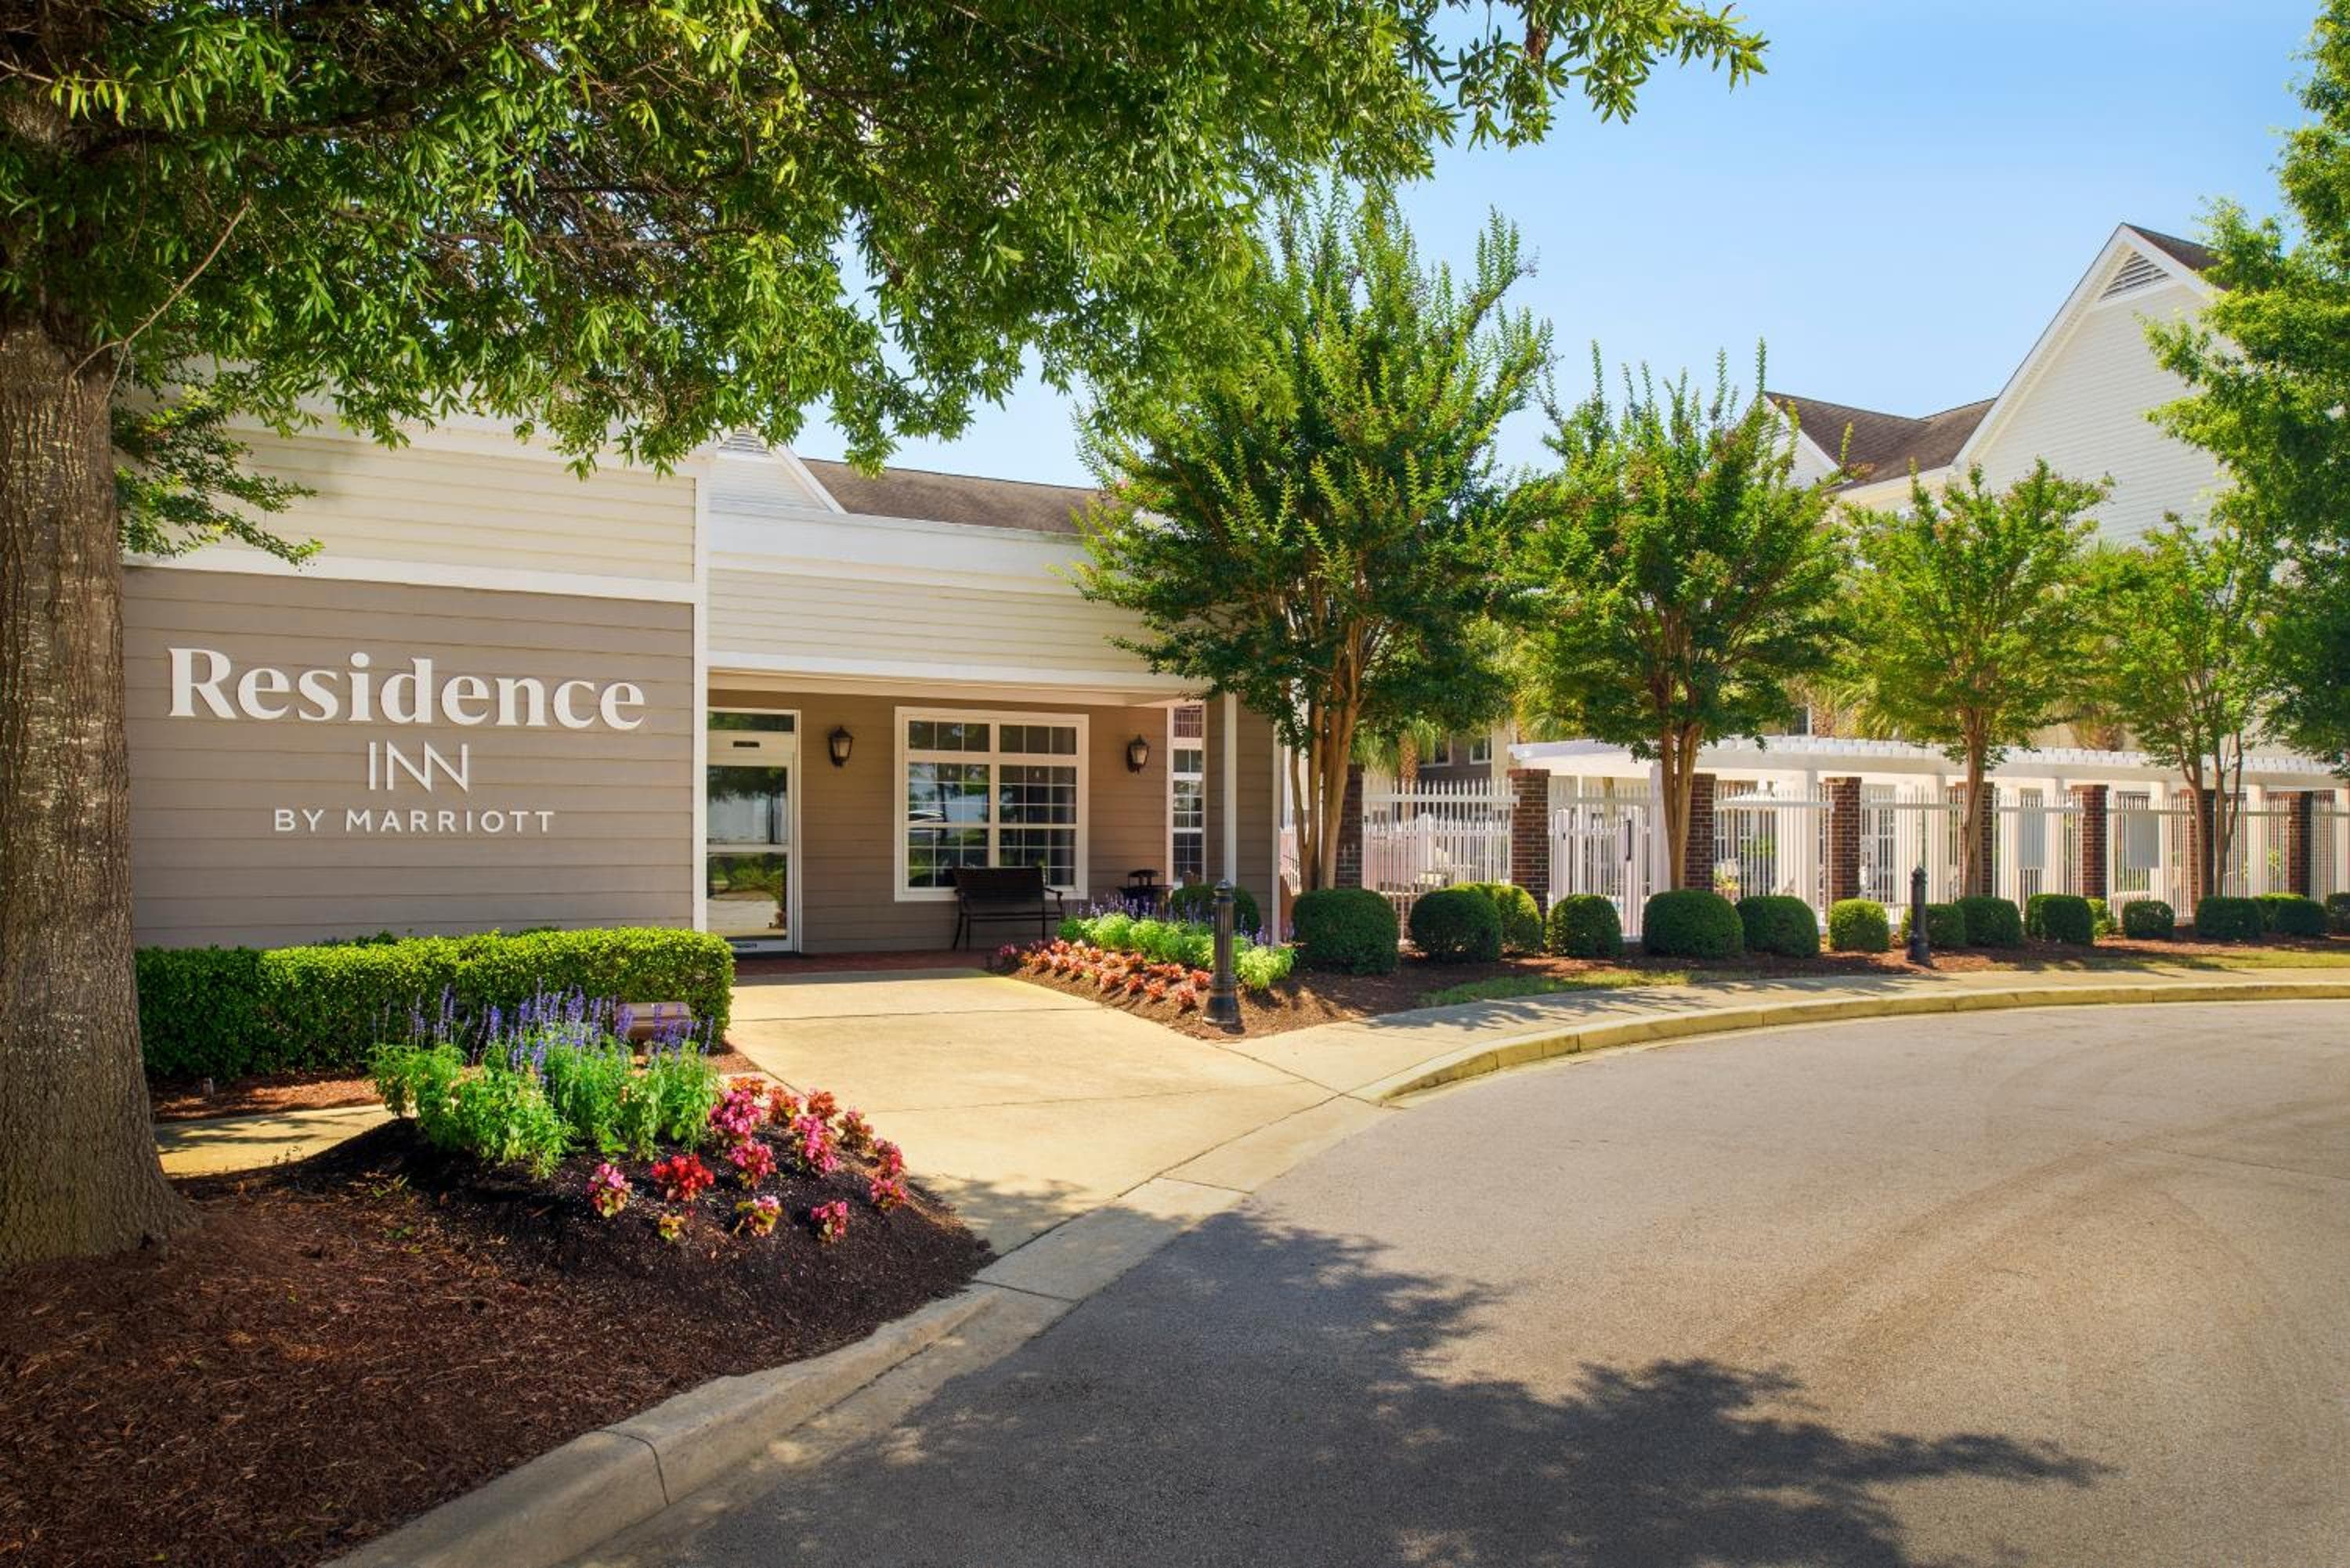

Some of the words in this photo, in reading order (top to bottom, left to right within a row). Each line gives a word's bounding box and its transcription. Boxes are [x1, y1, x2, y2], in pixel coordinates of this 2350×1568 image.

[168, 647, 645, 731] Residence
[368, 741, 469, 793] INN
[274, 808, 324, 832] BY
[345, 809, 555, 833] MARRIOTT
